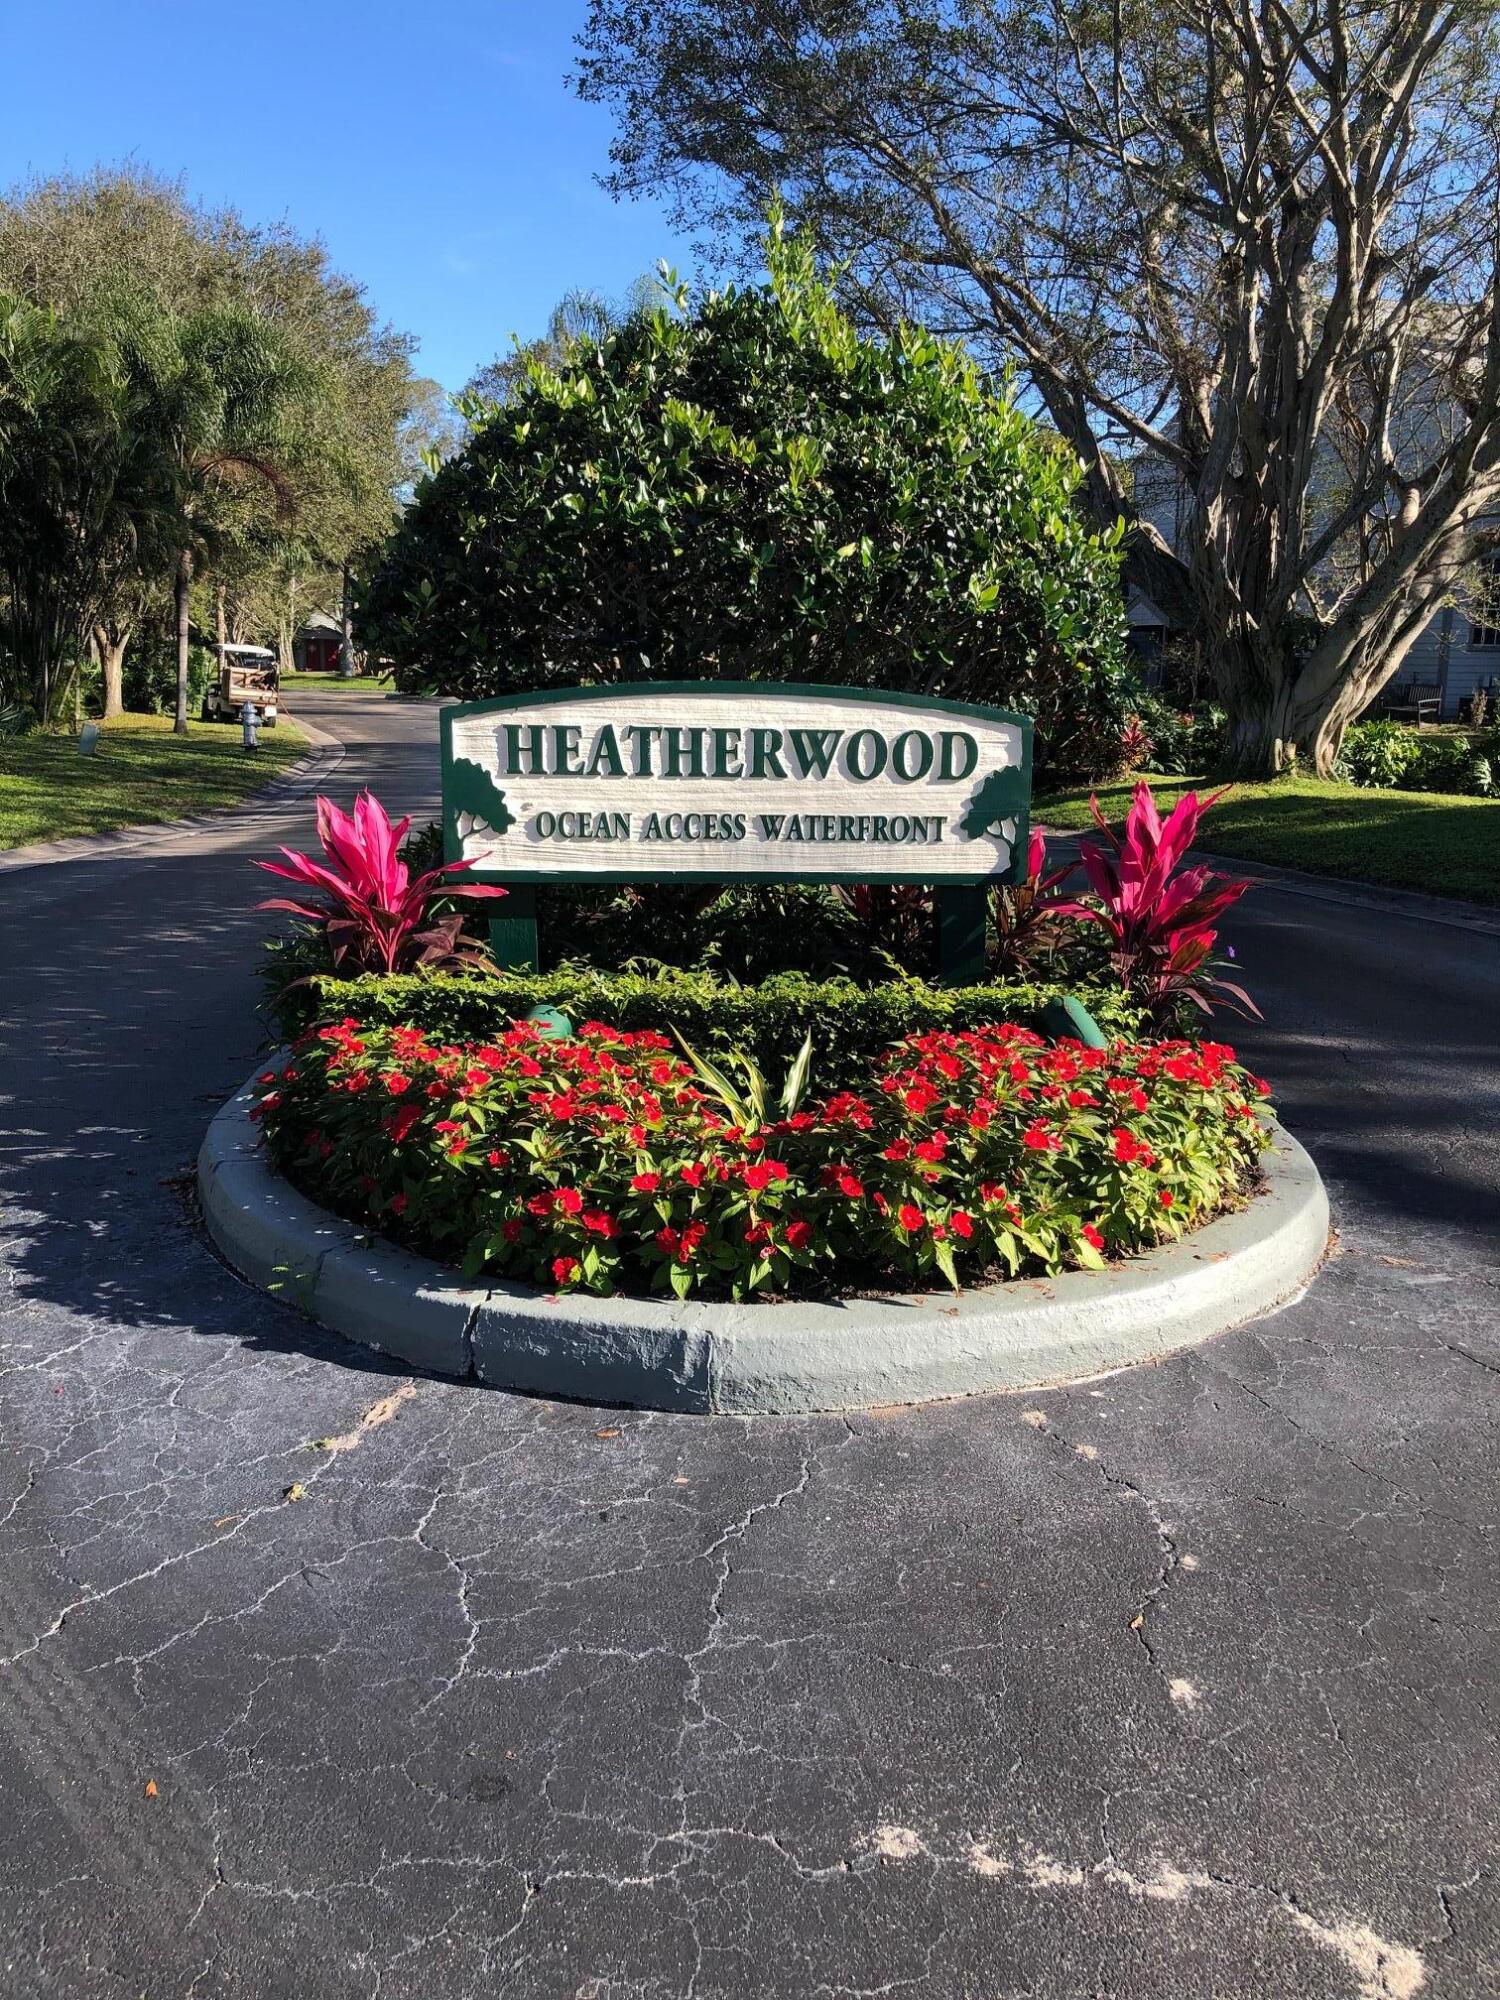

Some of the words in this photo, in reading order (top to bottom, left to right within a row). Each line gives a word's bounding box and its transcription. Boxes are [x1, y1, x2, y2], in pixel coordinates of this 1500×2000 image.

[502, 724, 979, 782] HEATHERWOOD
[535, 811, 630, 840] OCEAN
[643, 812, 747, 841] ACCESS
[761, 814, 948, 843] WATERFRONT
